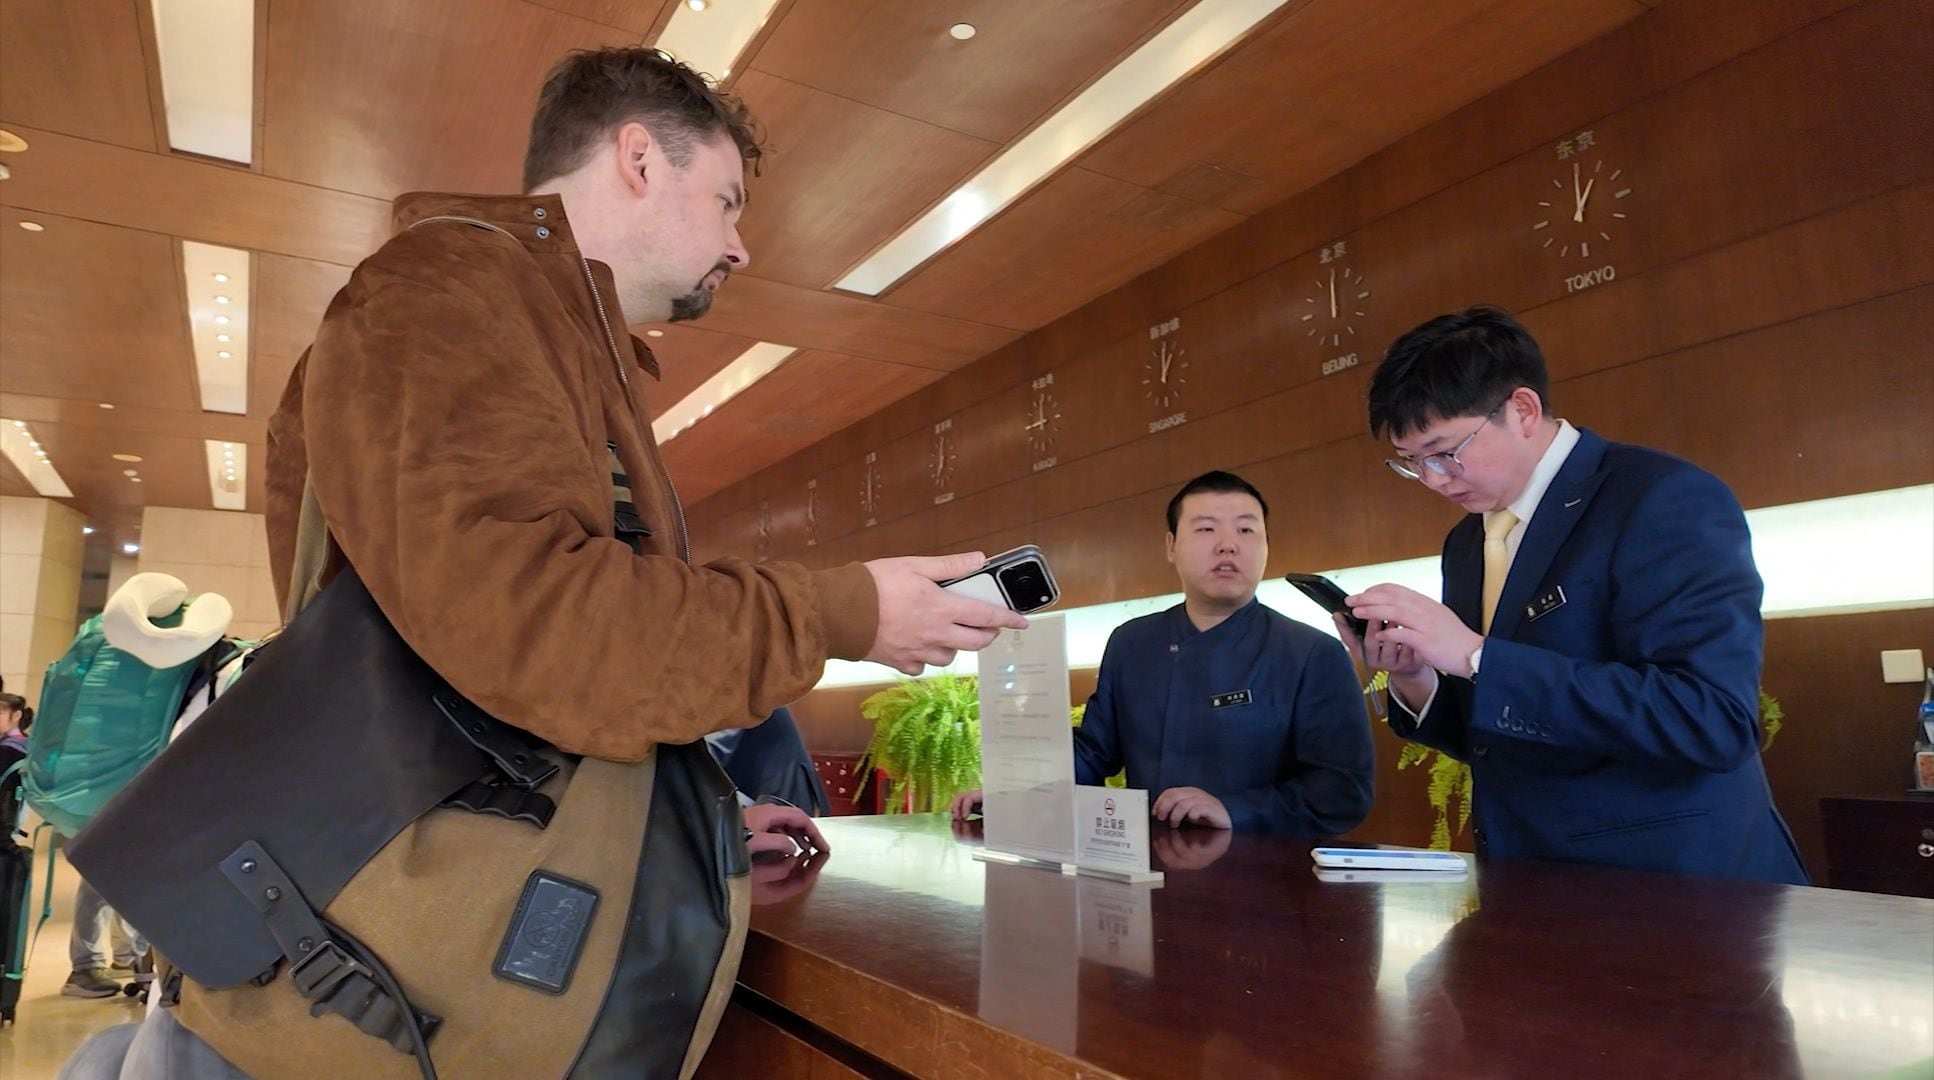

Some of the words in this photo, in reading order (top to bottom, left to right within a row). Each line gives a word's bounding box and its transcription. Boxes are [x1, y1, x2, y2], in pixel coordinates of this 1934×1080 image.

[1556, 130, 1596, 161] 东京
[1320, 241, 1347, 264] 北京
[1564, 265, 1616, 293] TOKYO
